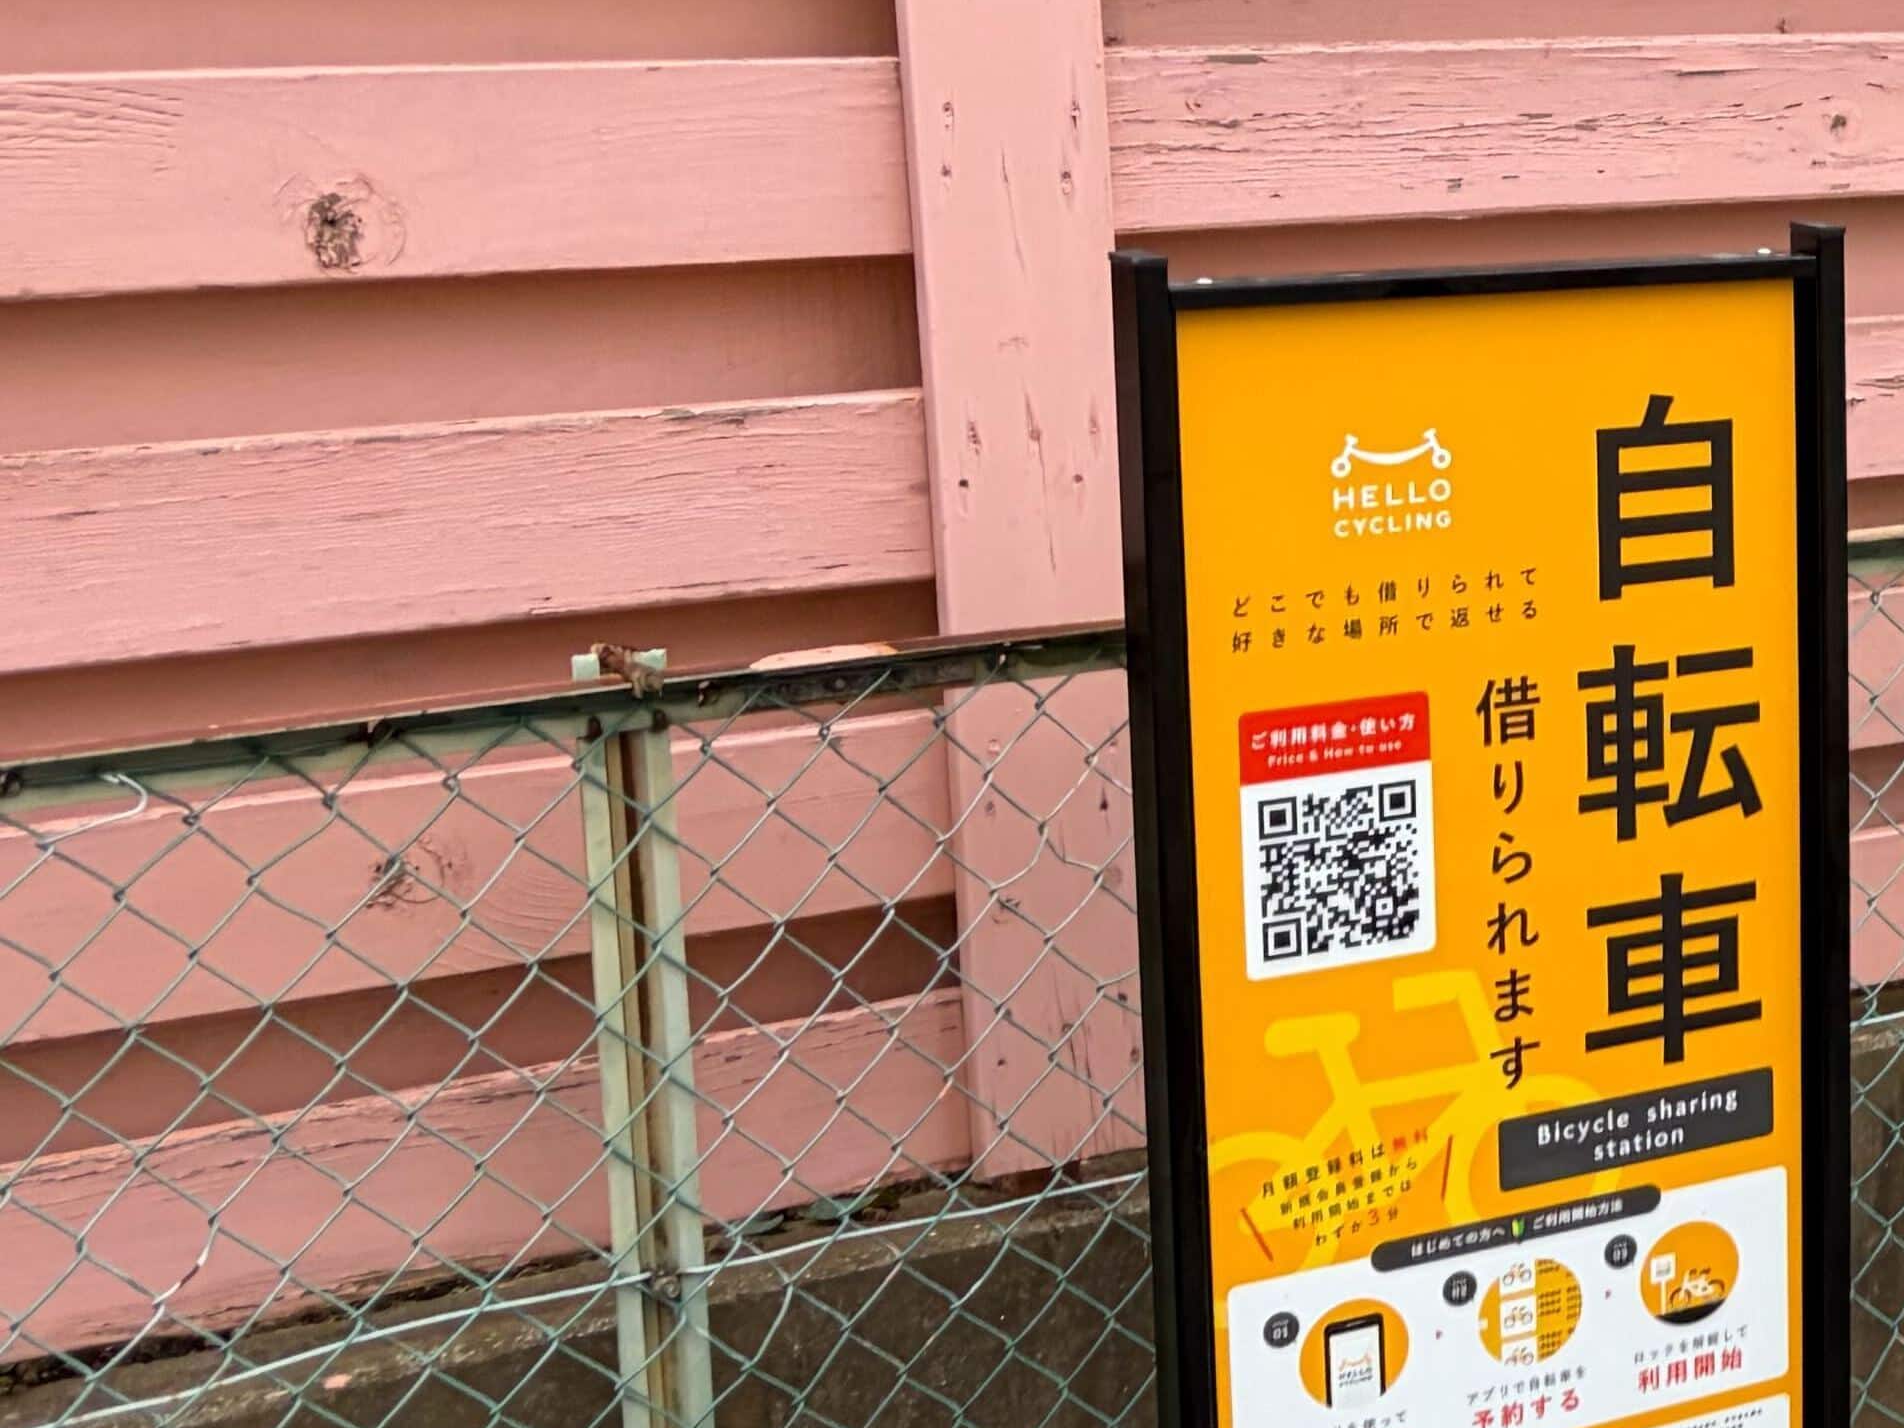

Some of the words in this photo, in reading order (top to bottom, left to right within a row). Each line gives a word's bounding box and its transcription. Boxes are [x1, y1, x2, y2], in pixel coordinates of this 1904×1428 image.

[1333, 478, 1452, 511] HELLO
[1334, 510, 1452, 537] CYCLING
[1232, 567, 1537, 618] どこでも借りられて
[1231, 599, 1538, 653] 好きな場所で返せる
[1578, 394, 1763, 1065] 自転車
[1267, 753, 1303, 768] Price
[1324, 745, 1353, 760] How
[1359, 743, 1374, 755] to
[1379, 740, 1402, 753] use
[1475, 678, 1542, 1090] 借りられます
[1536, 1108, 1630, 1146] Bicycle
[1646, 1088, 1739, 1123] sharing
[1593, 1125, 1684, 1162] station
[1411, 1226, 1505, 1259] はじめての方へ
[1638, 1346, 1742, 1394] 利用開始
